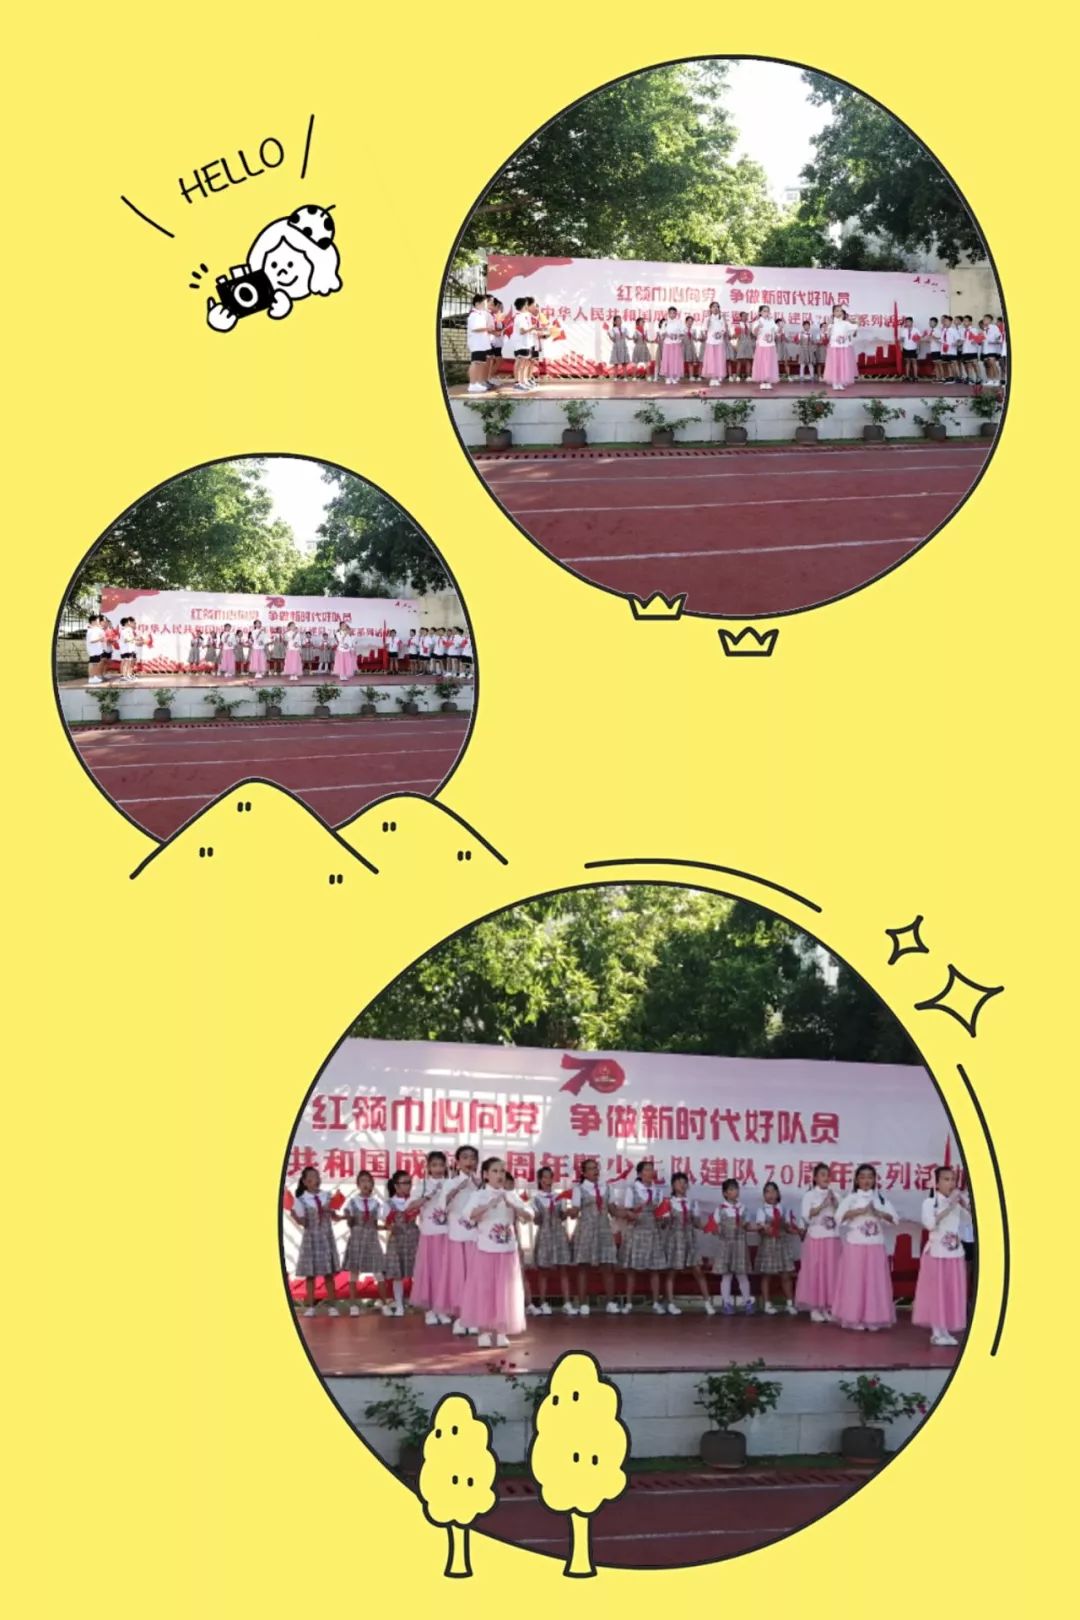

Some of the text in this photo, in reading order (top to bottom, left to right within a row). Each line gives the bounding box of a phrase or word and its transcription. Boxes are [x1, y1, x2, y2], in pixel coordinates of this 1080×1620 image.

[729, 288, 850, 308] 争做新时代好队员
[559, 1053, 625, 1096] 70
[311, 1094, 840, 1143] 红领巾心向党 争做新时代好队员
